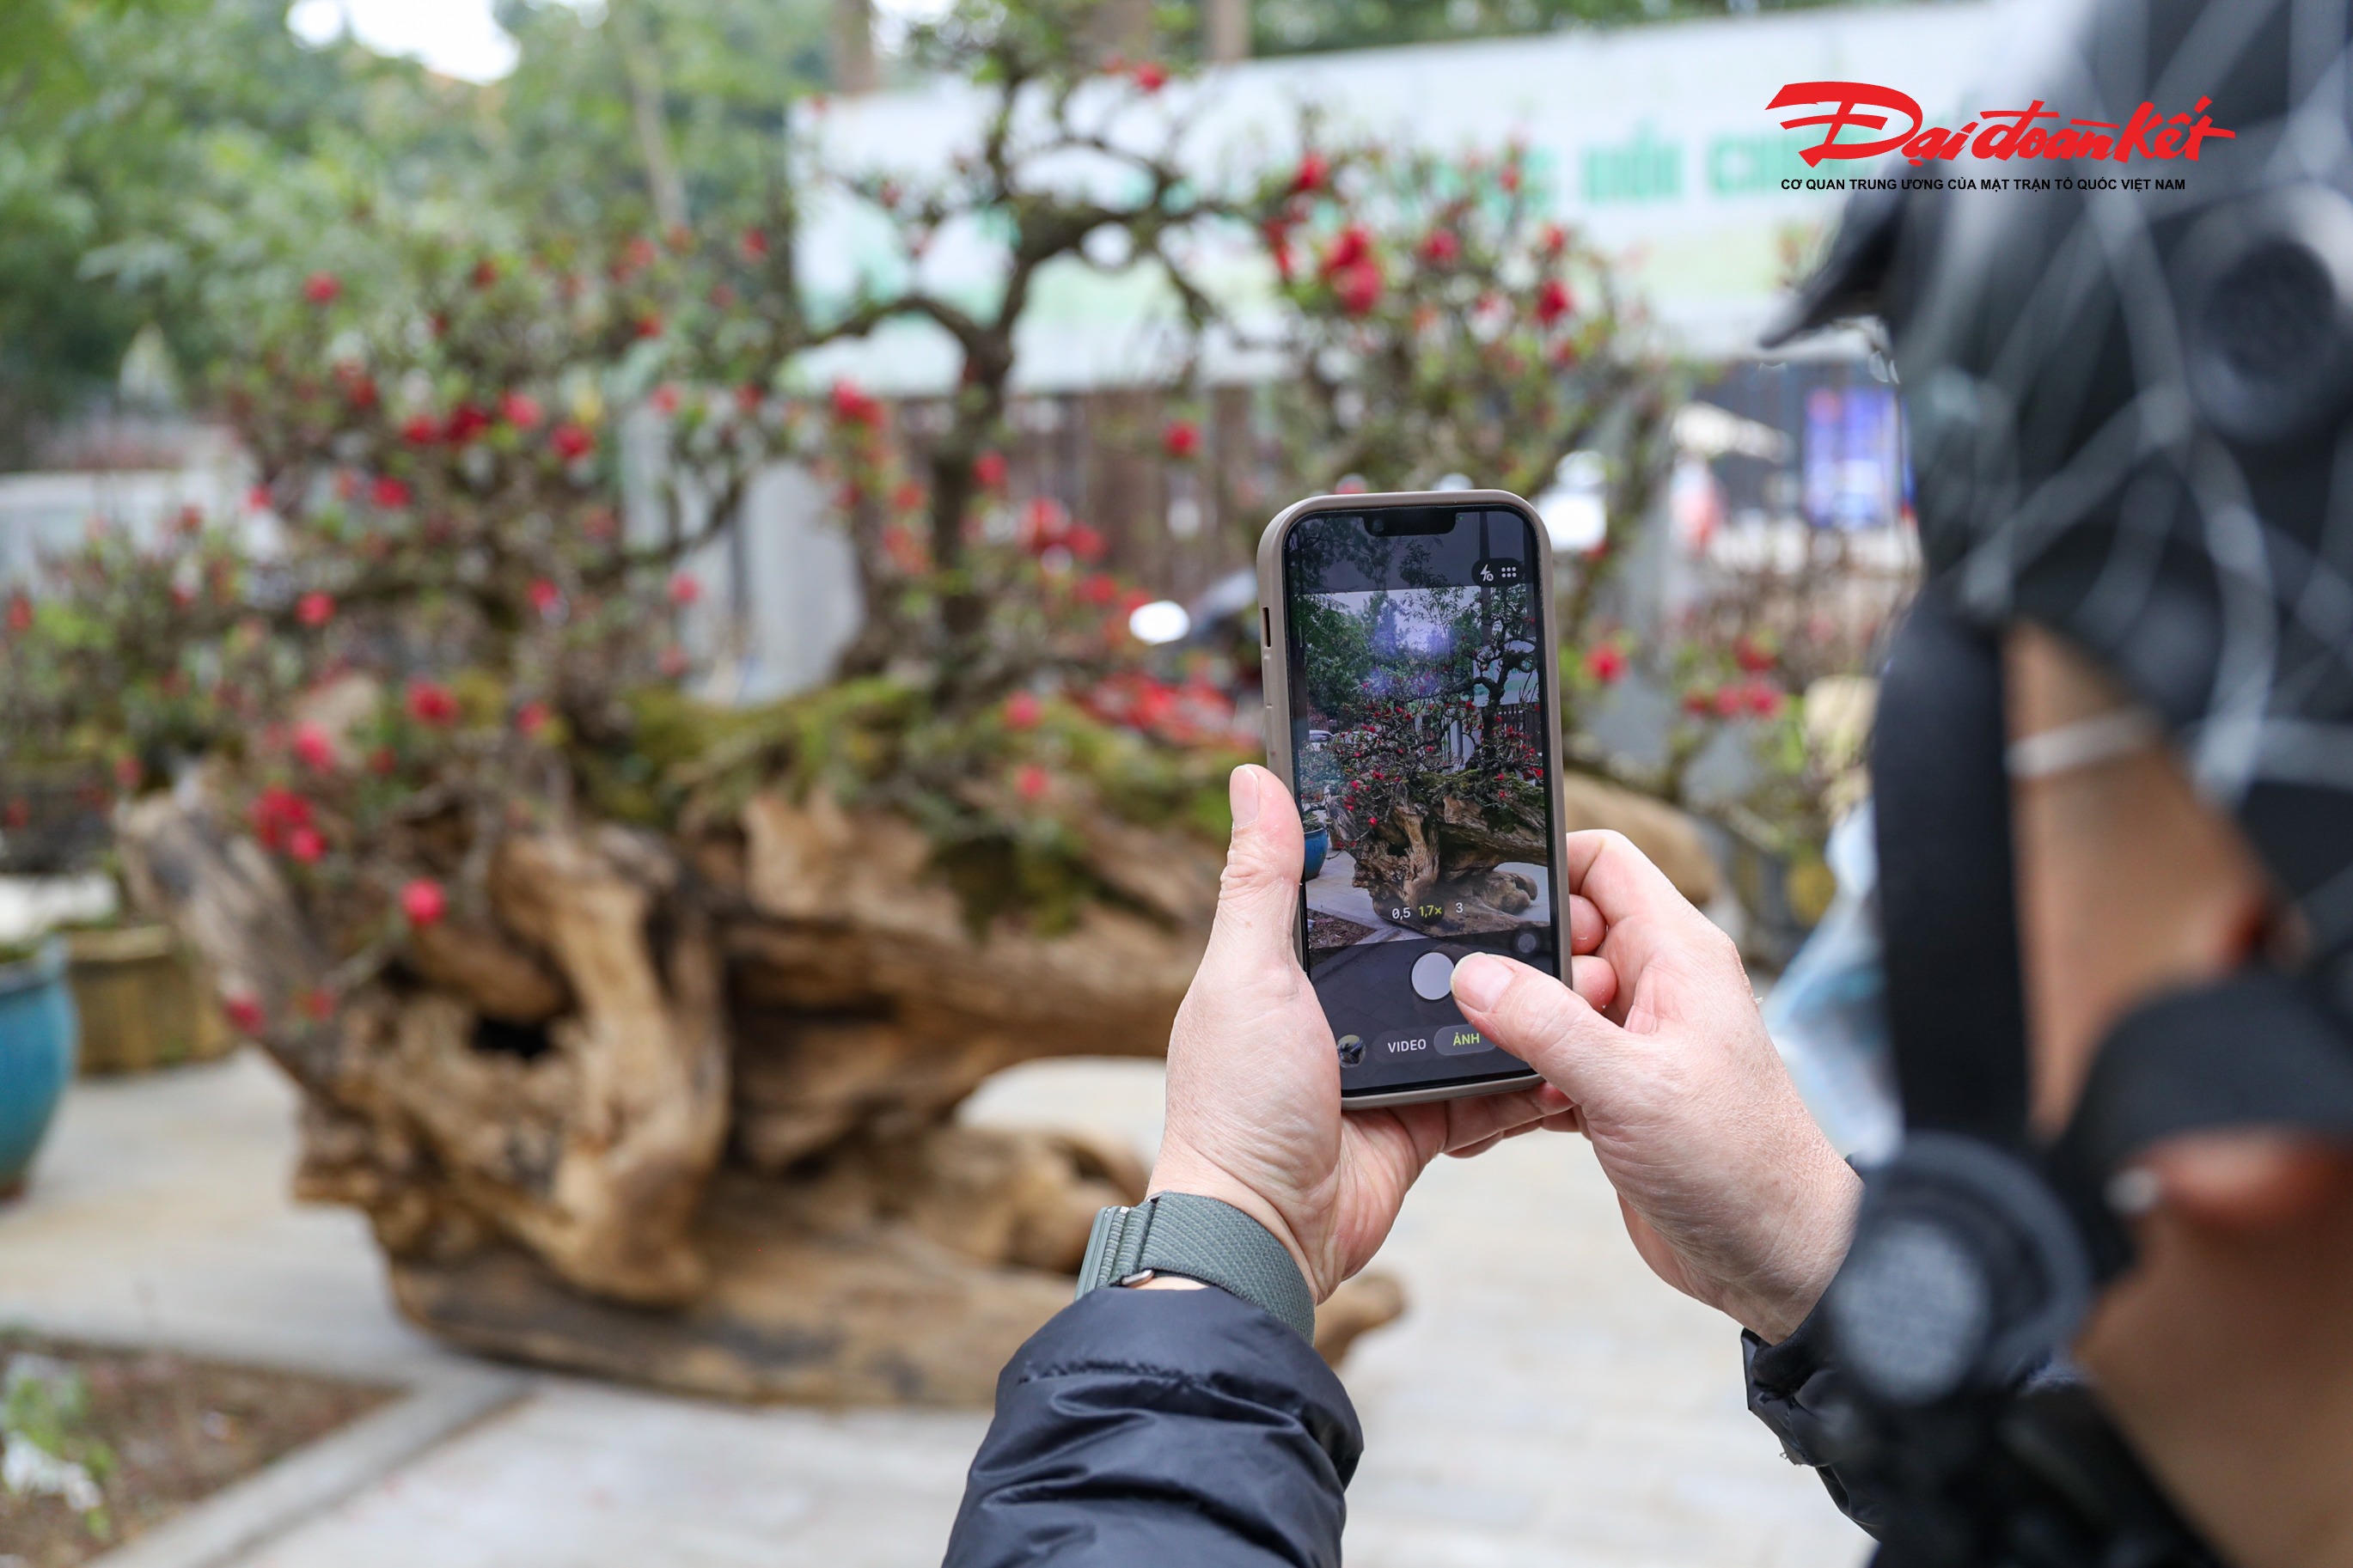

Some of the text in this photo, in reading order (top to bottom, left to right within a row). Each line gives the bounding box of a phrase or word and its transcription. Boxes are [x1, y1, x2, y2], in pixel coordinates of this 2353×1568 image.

[1392, 906, 1411, 920] 0,5
[1456, 901, 1464, 913] 3
[1387, 1039, 1427, 1053] VIDEO
[1452, 1032, 1481, 1046] ẢNH
